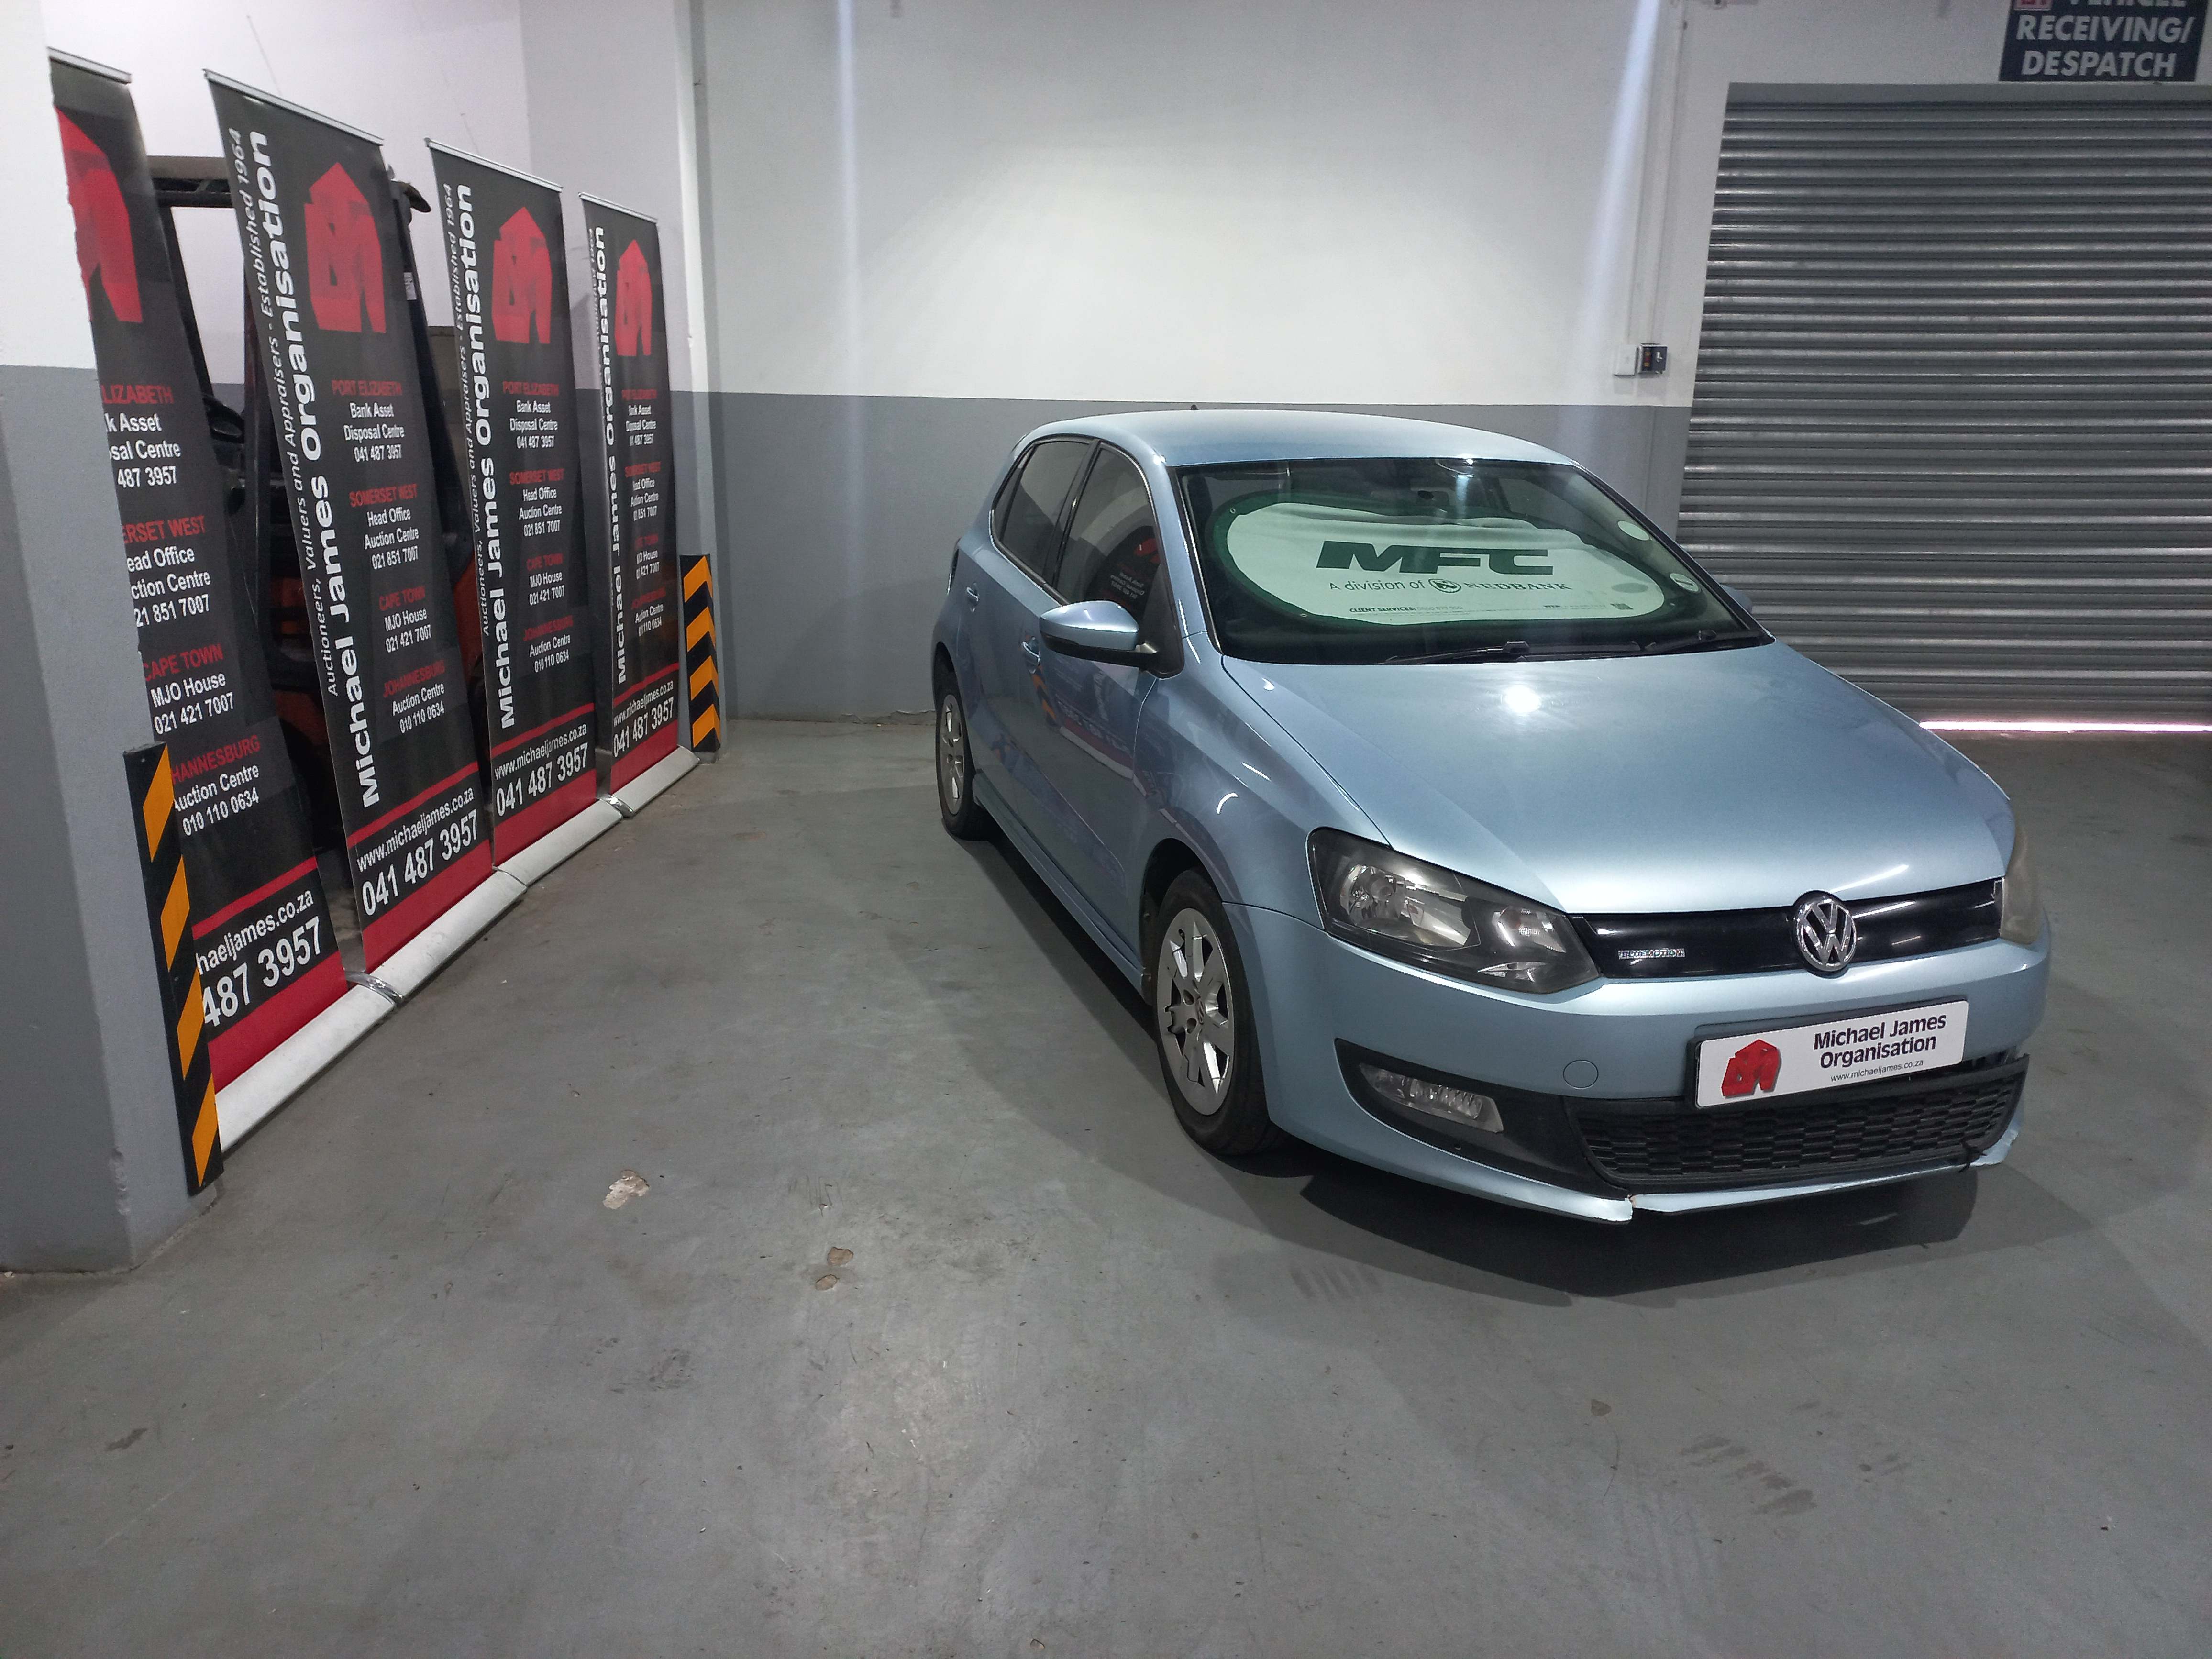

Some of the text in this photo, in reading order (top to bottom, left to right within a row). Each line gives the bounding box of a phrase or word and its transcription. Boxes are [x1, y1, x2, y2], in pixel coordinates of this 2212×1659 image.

[2016, 14, 2196, 44] RECEIVING/
[2021, 50, 2177, 77] DESPATCH
[101, 385, 175, 404] LIZABETH
[516, 400, 531, 413] Bank
[120, 412, 162, 432] Asset
[229, 128, 338, 696] Auctioneers, Valuers and Appraisers Established 1964
[349, 402, 394, 418] Bank Asset
[343, 423, 405, 443] Disposal Centre
[509, 418, 537, 433] Disposal
[135, 440, 181, 459] Centre
[354, 444, 402, 462] 041 487 3957
[517, 435, 527, 449] 041
[118, 465, 177, 488] 487 3957
[349, 486, 397, 508] SOMERSET
[523, 487, 557, 501] Head Office
[367, 507, 411, 527] Head Office
[481, 457, 503, 578] James
[519, 505, 542, 520] Auction
[122, 515, 205, 544] ERSET WEST
[364, 526, 419, 550] Auction Centre
[524, 524, 534, 537] 021
[535, 522, 546, 535] 851
[127, 546, 195, 572] ead Office
[311, 475, 350, 623] James
[372, 546, 419, 570] 021 851 7007
[1316, 540, 1553, 575] MFC
[131, 570, 210, 600] ction Centre
[542, 572, 563, 585] House
[1329, 579, 1572, 591] A division of NEDBANK
[379, 585, 426, 611] CAPE TOWN
[529, 585, 565, 606] 021 421 7007
[134, 594, 209, 627] 21 851 7007
[384, 608, 427, 632] MJO House
[386, 624, 431, 653] 021 421 7007
[530, 634, 571, 658] Auction Centre
[143, 643, 223, 681] CAPE TOWN
[489, 587, 515, 729] Michael
[534, 649, 570, 673] 010 110 0634
[151, 673, 226, 708] MJO House
[392, 682, 445, 716] Auction Centre
[154, 692, 234, 735] 021 421 7007
[335, 635, 380, 809] Michael
[399, 700, 445, 734] 010 110 0634
[614, 696, 674, 757] 041 487 3957
[171, 734, 260, 785] HANNESBURG
[495, 722, 587, 780] www.michaeljames.co.za
[219, 765, 259, 792] Centre
[496, 742, 588, 817] 041 487 3957
[182, 786, 259, 836] 010 110 0634
[357, 786, 474, 873] www.michaeljames.co.za
[361, 810, 478, 917] 041 487 3957
[195, 890, 314, 975] haeljames.co.za
[202, 916, 321, 1028] 487 3957
[1814, 1014, 1947, 1050] Michael James
[1820, 1036, 1936, 1069] Organisation
[1830, 1060, 1924, 1082] www.michaeljames.co.za
